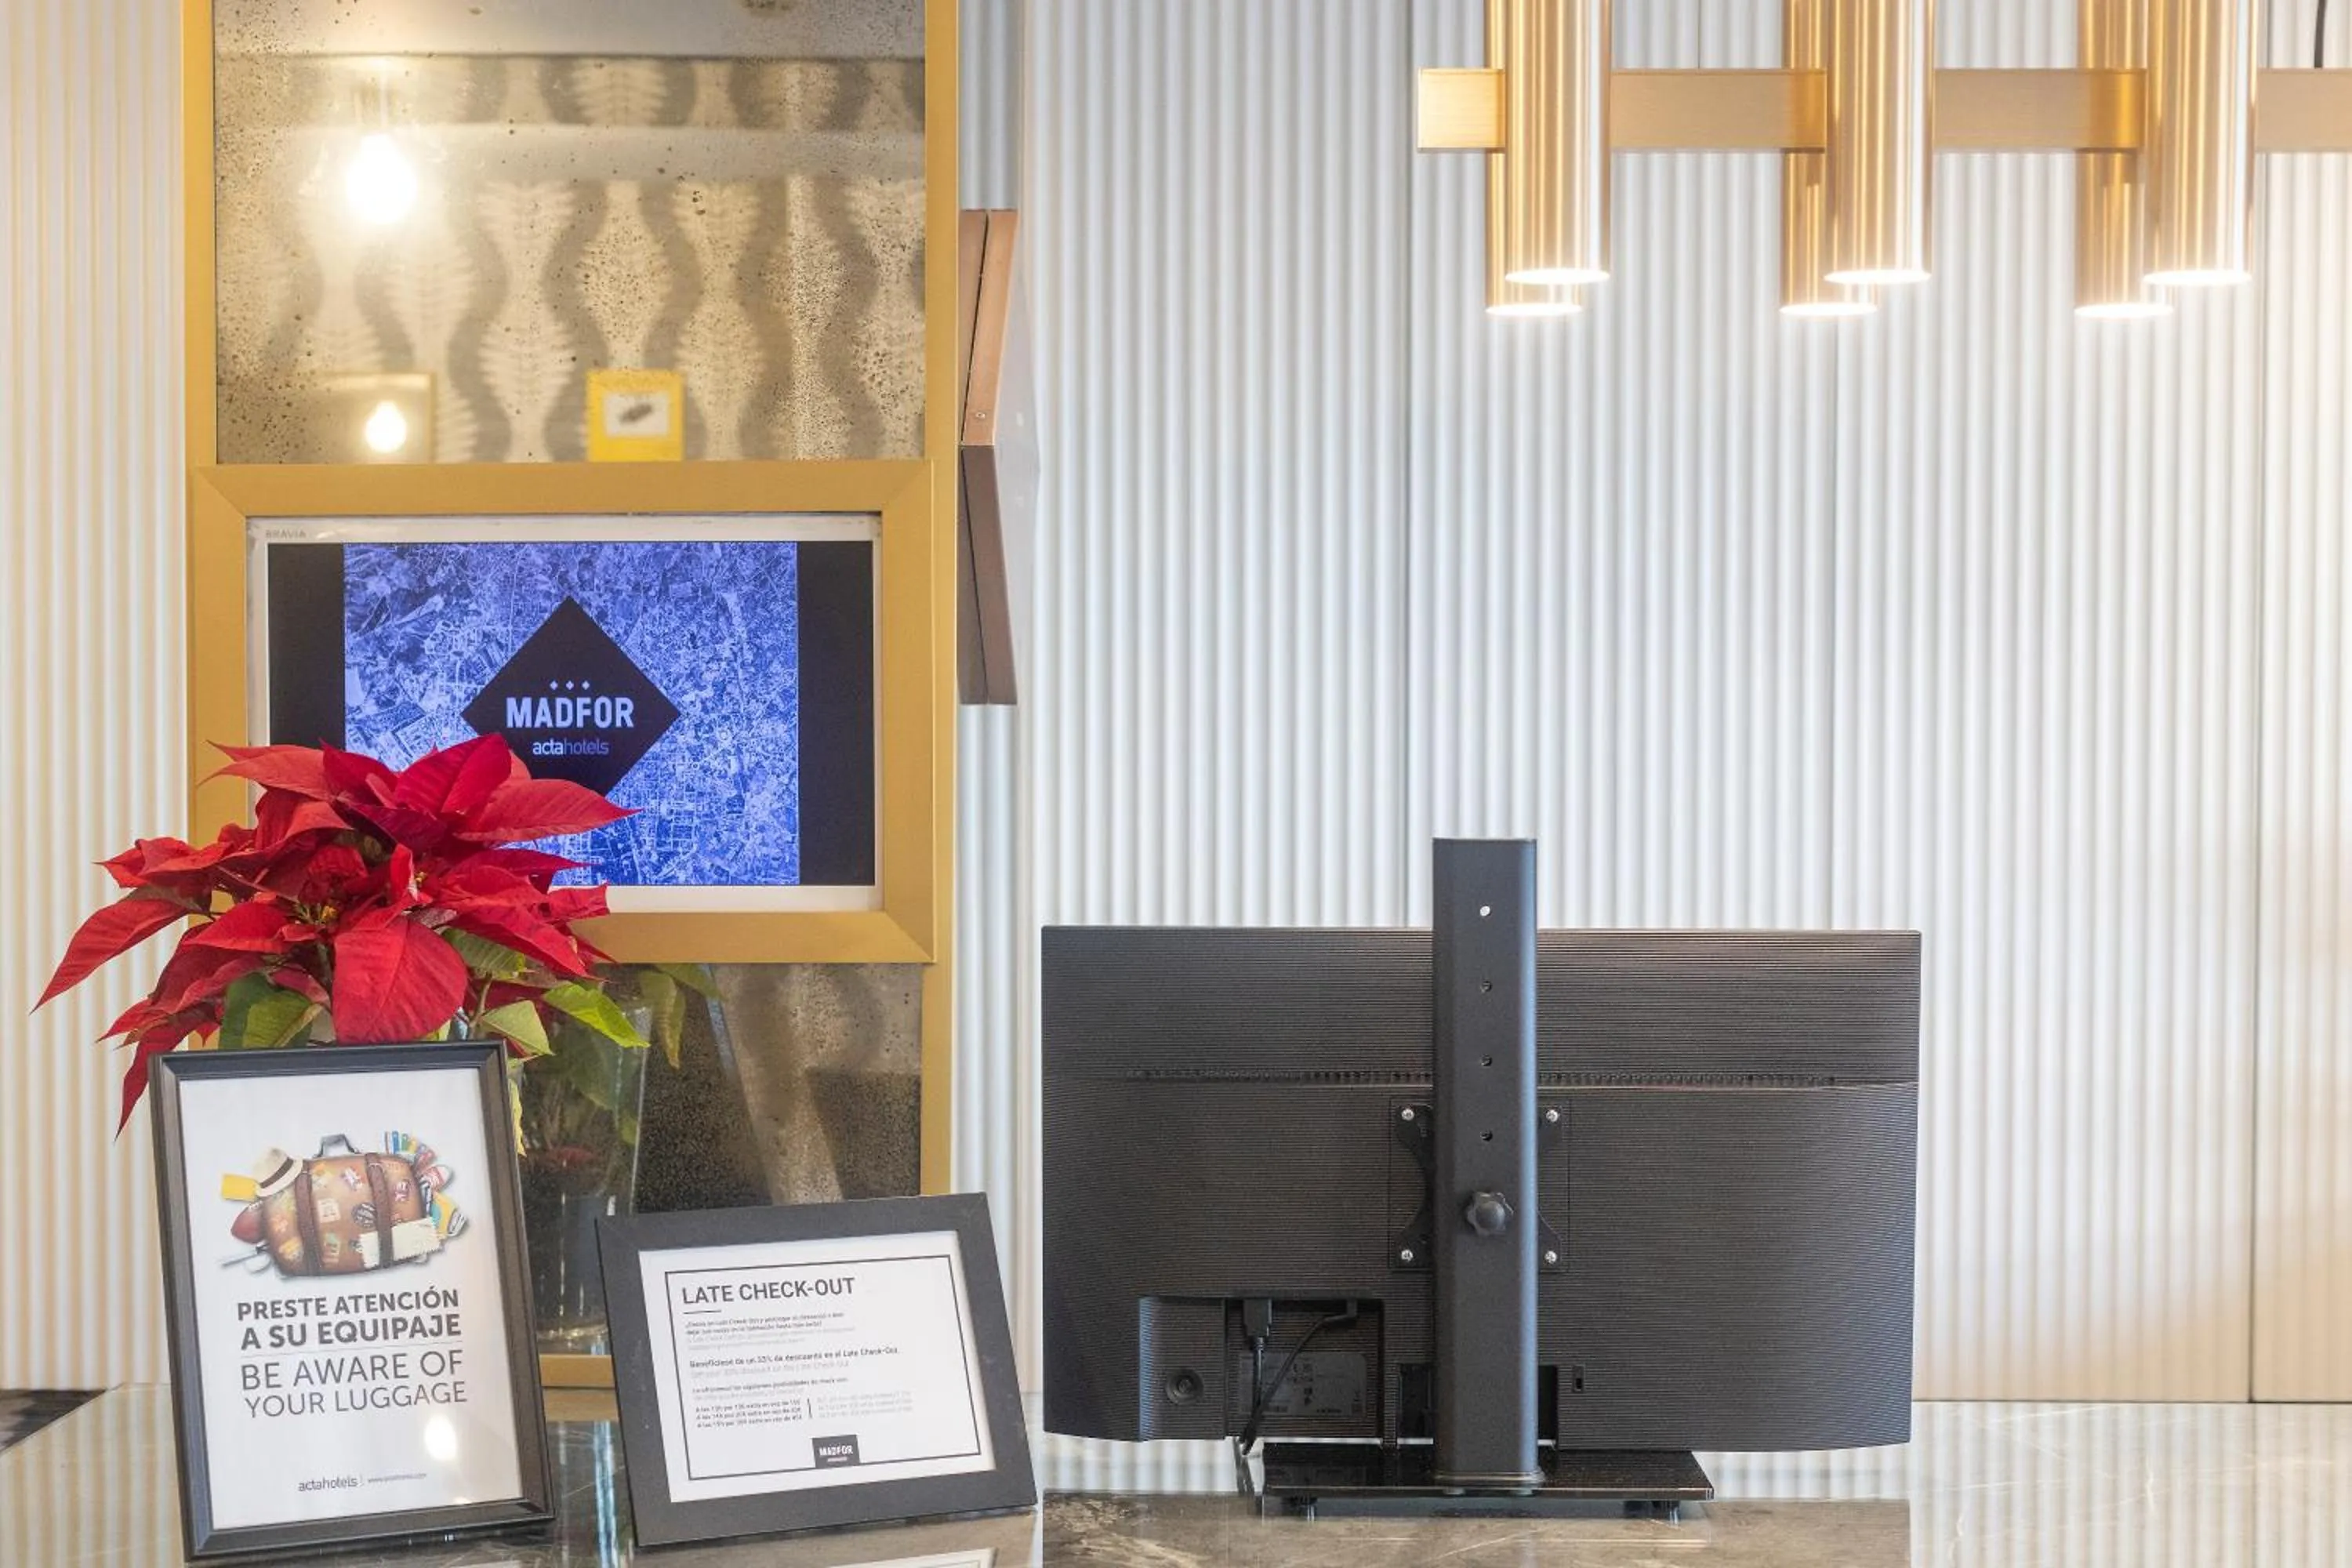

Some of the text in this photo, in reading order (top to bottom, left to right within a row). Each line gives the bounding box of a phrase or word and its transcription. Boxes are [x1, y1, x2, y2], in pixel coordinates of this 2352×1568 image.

[506, 696, 635, 728] MADFOR
[532, 738, 609, 755] actahotels
[238, 1286, 459, 1321] PRESTE ATENCIÓN
[682, 1277, 855, 1304] LATE CHECK-OUT
[241, 1313, 462, 1350] A SU EQUIPAJE
[241, 1349, 463, 1391] BE AWARE OF
[245, 1381, 468, 1418] YOUR LUGGAGE
[298, 1475, 359, 1491] actahotels
